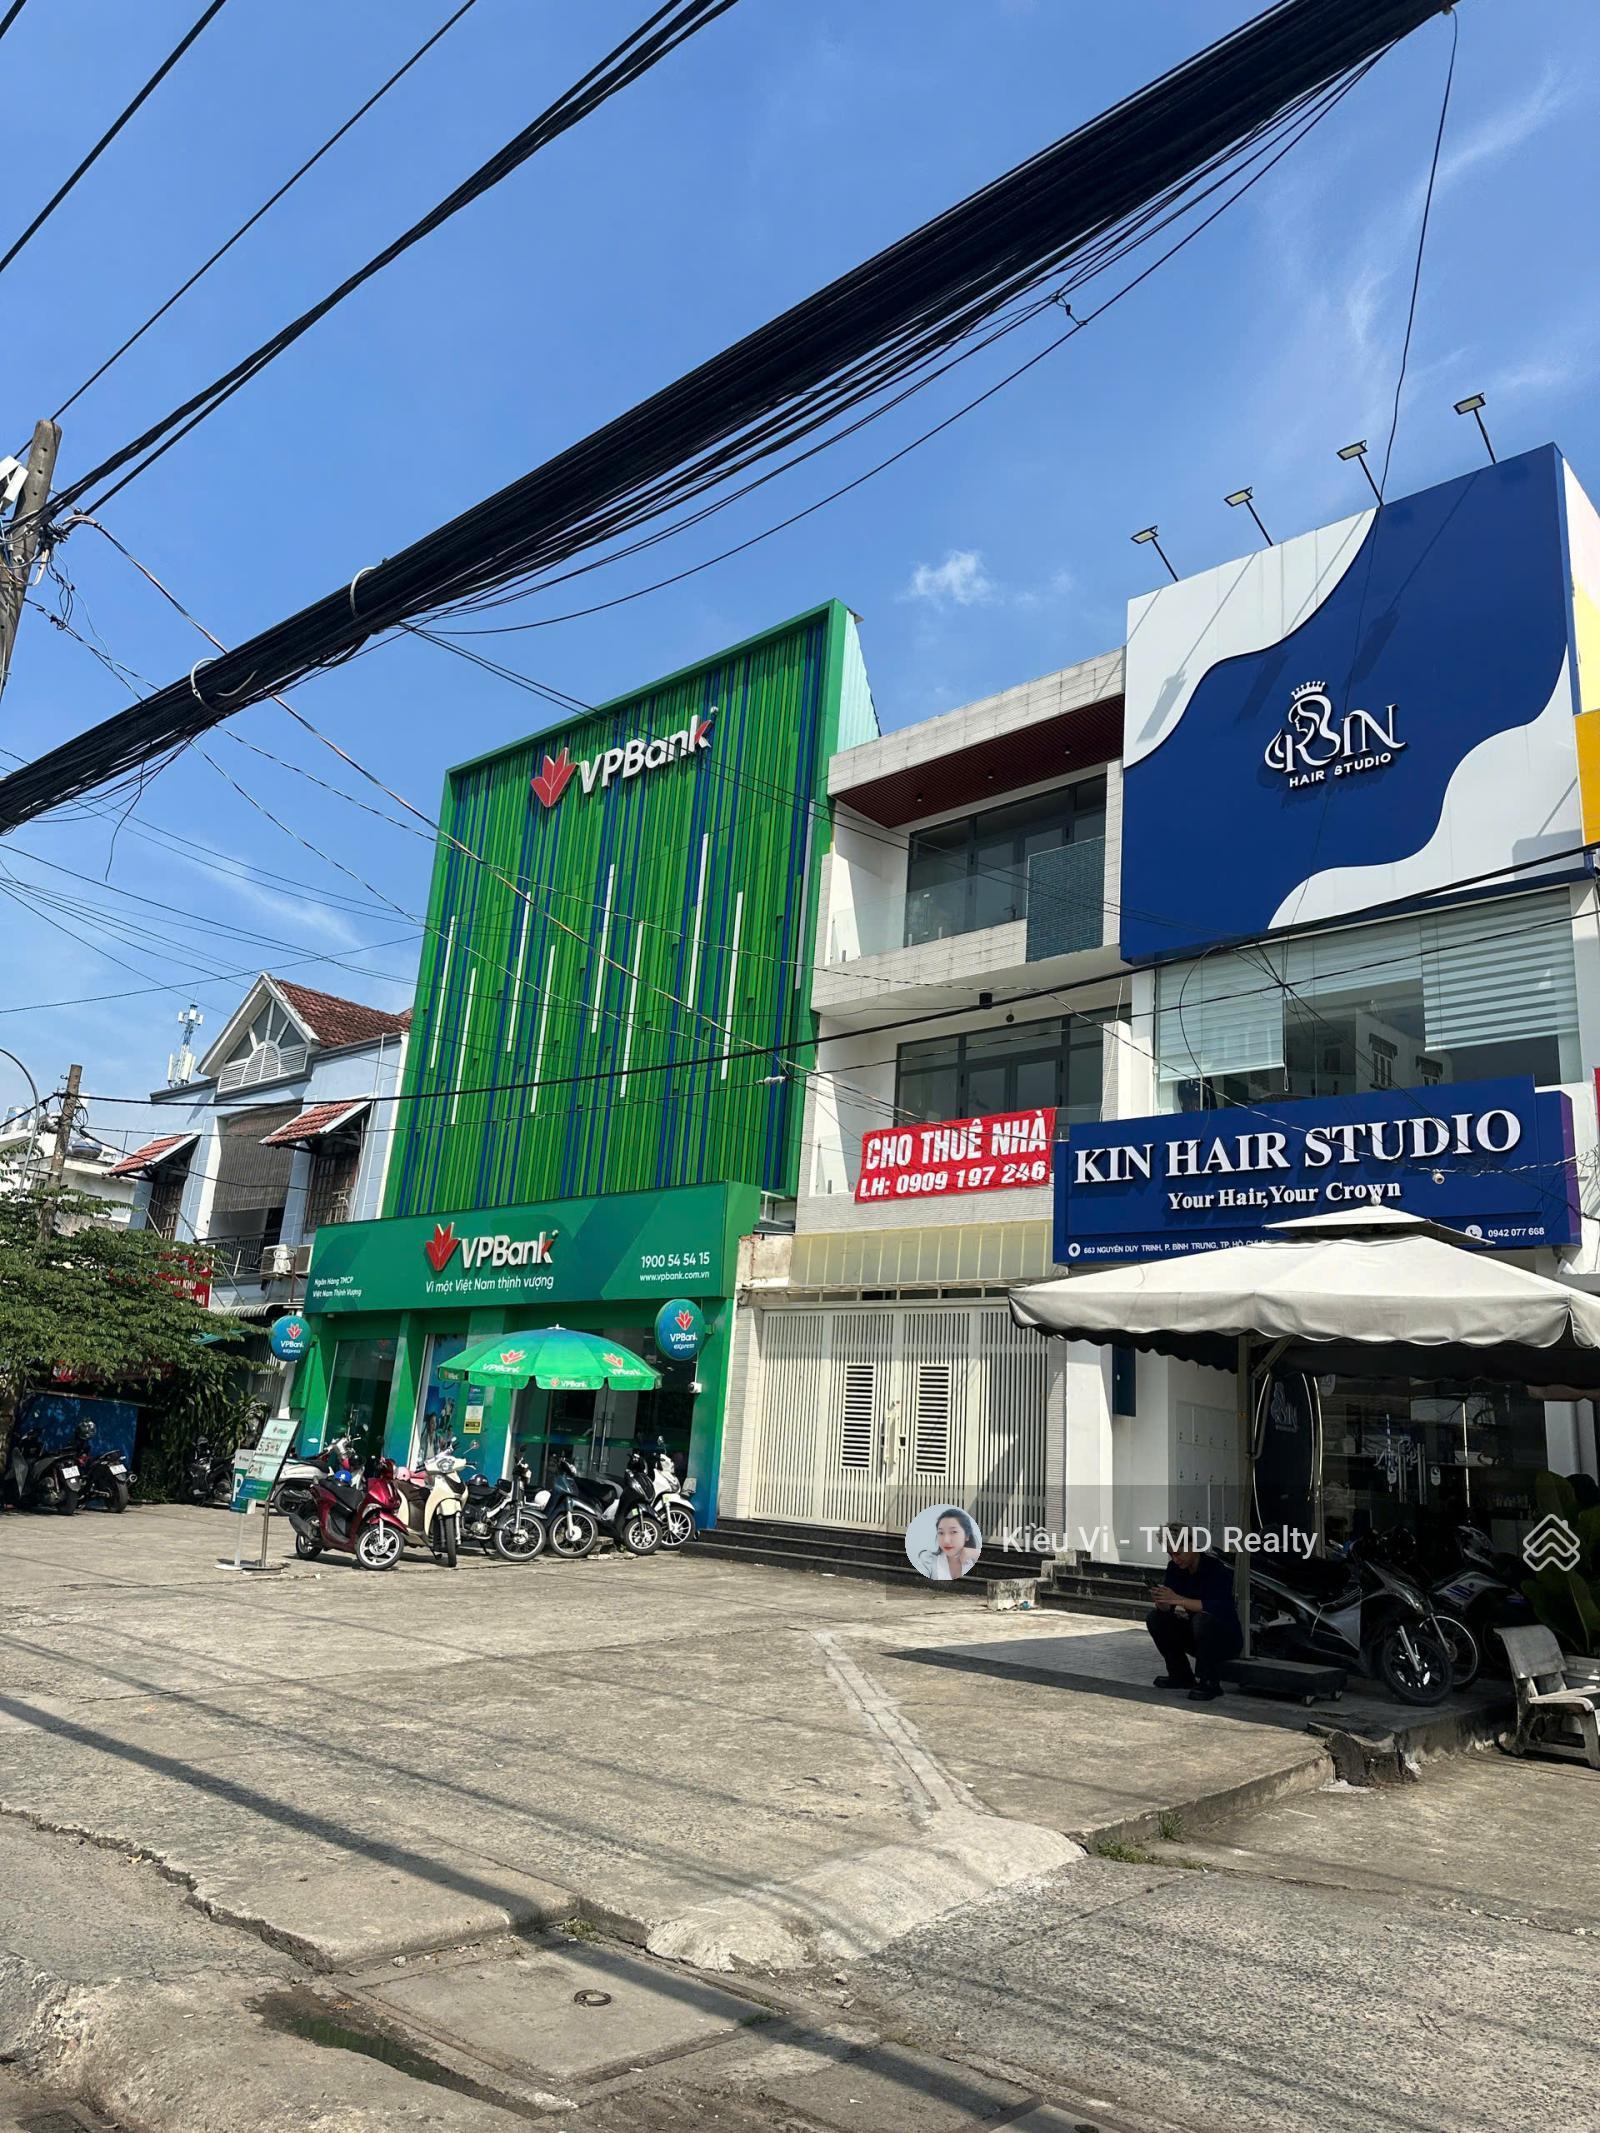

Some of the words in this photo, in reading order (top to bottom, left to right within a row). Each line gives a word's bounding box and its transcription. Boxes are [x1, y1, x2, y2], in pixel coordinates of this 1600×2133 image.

[579, 714, 712, 794] VPBank
[1289, 770, 1326, 788] HAIR
[1334, 752, 1392, 776] STUDIO
[866, 1134, 913, 1170] CHO
[921, 1118, 984, 1164] THUÊ
[991, 1110, 1047, 1156] NHÀ
[1073, 1143, 1154, 1184] KIN
[1165, 1131, 1291, 1177] HAIR
[1305, 1110, 1521, 1168] STUDIO
[859, 1177, 891, 1198] LH:
[896, 1171, 949, 1194] 0909
[956, 1166, 996, 1188] 197
[1001, 1160, 1047, 1184] 246
[1168, 1191, 1215, 1210] Your
[1325, 1181, 1402, 1202] Crown
[1488, 1228, 1511, 1238] 0942
[1511, 1227, 1527, 1237] 077
[1527, 1226, 1545, 1236] 668
[461, 1230, 555, 1269] VPBank
[641, 1254, 666, 1269] 1900
[667, 1253, 681, 1267] 54
[683, 1252, 697, 1266] 54
[699, 1251, 711, 1265] 15
[1124, 1245, 1139, 1253] DUY
[1164, 1243, 1171, 1251] P.
[435, 1277, 453, 1295] một
[455, 1277, 473, 1295] Việt
[474, 1277, 496, 1292] Nam
[497, 1275, 521, 1293] thịnh
[523, 1274, 555, 1291] vượng
[639, 1270, 710, 1282] www.vpbank.com.vn
[280, 1340, 304, 1349] VPBank
[670, 1332, 697, 1342] VPBank
